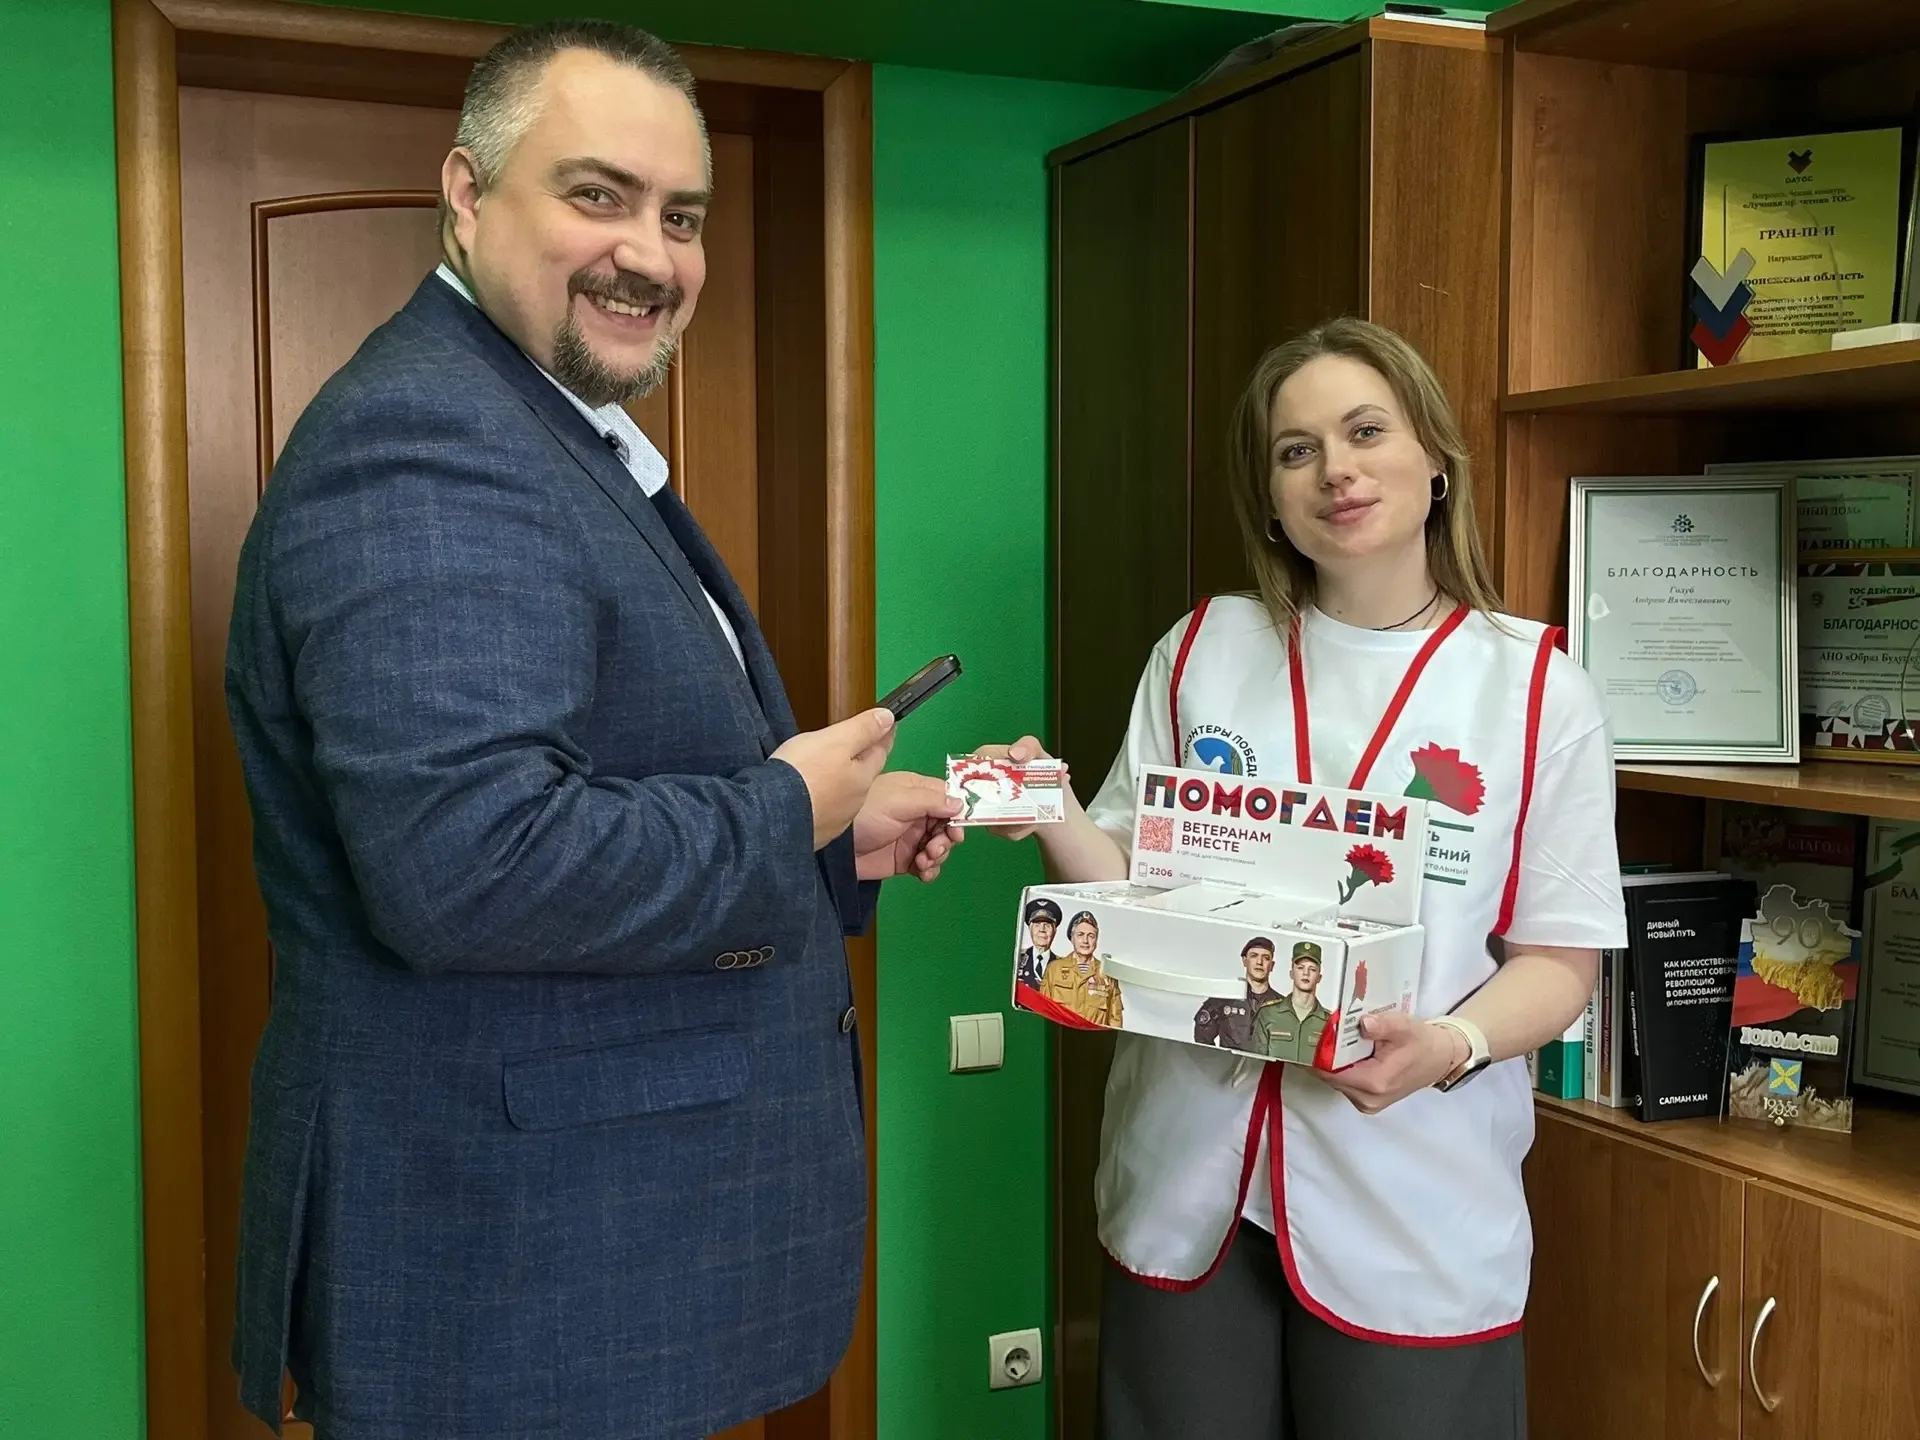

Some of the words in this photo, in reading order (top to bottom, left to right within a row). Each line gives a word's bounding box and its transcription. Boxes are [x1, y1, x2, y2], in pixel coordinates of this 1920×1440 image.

[1607, 566, 1758, 578] БЛАГОДАРНОСТЬ
[1849, 587, 1867, 595] ТОС
[1867, 585, 1916, 596] ДЕЙСТВУЙ
[1820, 651, 1843, 662] АНО
[1845, 651, 1879, 664] «Образ
[1182, 820, 1272, 844] ВЕТЕРАНАМ
[1181, 834, 1240, 854] ВМЕСТЕ
[1426, 846, 1471, 863] ЕНИЙ
[1149, 866, 1173, 878] 2206
[1646, 919, 1680, 931] ДИВНЫЙ
[1772, 914, 1824, 948] 90
[1647, 929, 1676, 940] НОВЫЙ
[1676, 929, 1696, 938] ПУТЬ
[1664, 960, 1680, 969] КАК
[1664, 967, 1708, 979] ИНТЕЛЛЕКТ
[1665, 977, 1715, 989] РЕВОЛЮЦИЮ
[1665, 989, 1672, 998] В
[1672, 985, 1728, 998] ОБРАЗОВАНИИ
[1673, 998, 1698, 1007] ПОЧЕМУ
[1586, 1018, 1595, 1054] ВОЙНА,
[1659, 1094, 1691, 1106] САЛМАН
[1692, 1093, 1708, 1102] ХАН
